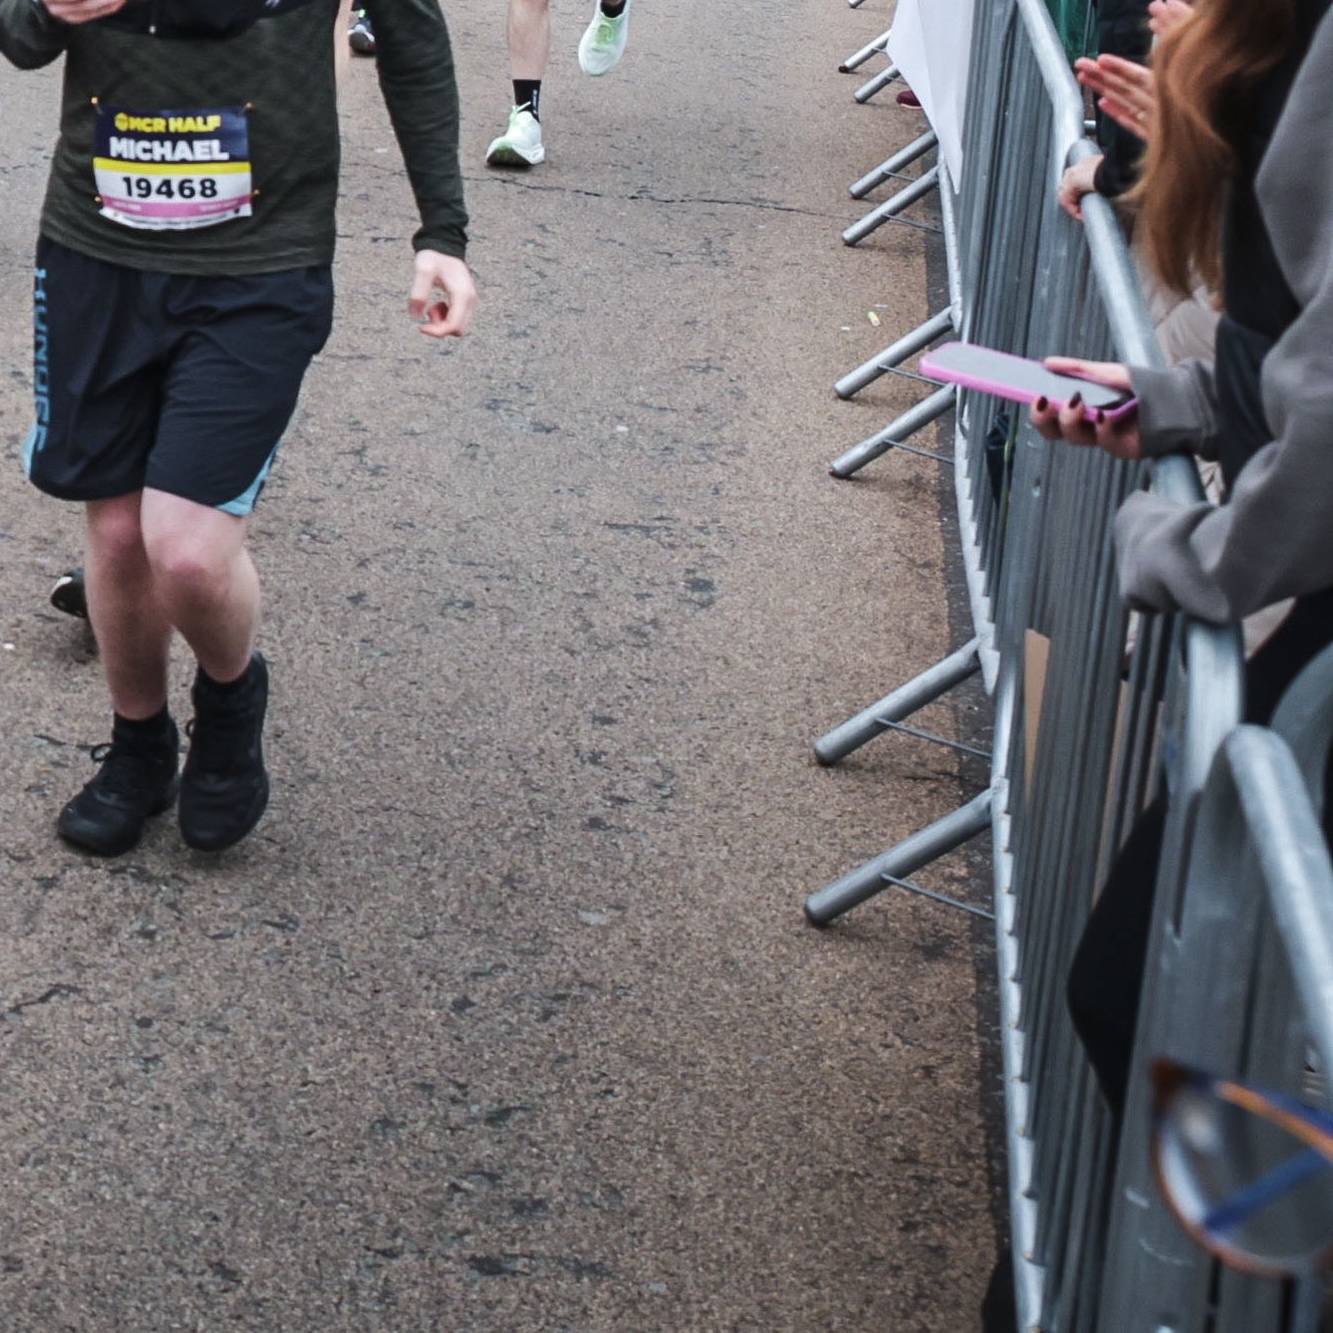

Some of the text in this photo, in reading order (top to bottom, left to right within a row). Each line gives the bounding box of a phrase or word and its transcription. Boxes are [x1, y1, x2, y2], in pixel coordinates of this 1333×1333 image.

[129, 114, 221, 133] MCR HALF
[109, 136, 230, 161] MICHAEL
[122, 176, 218, 199] 19468
